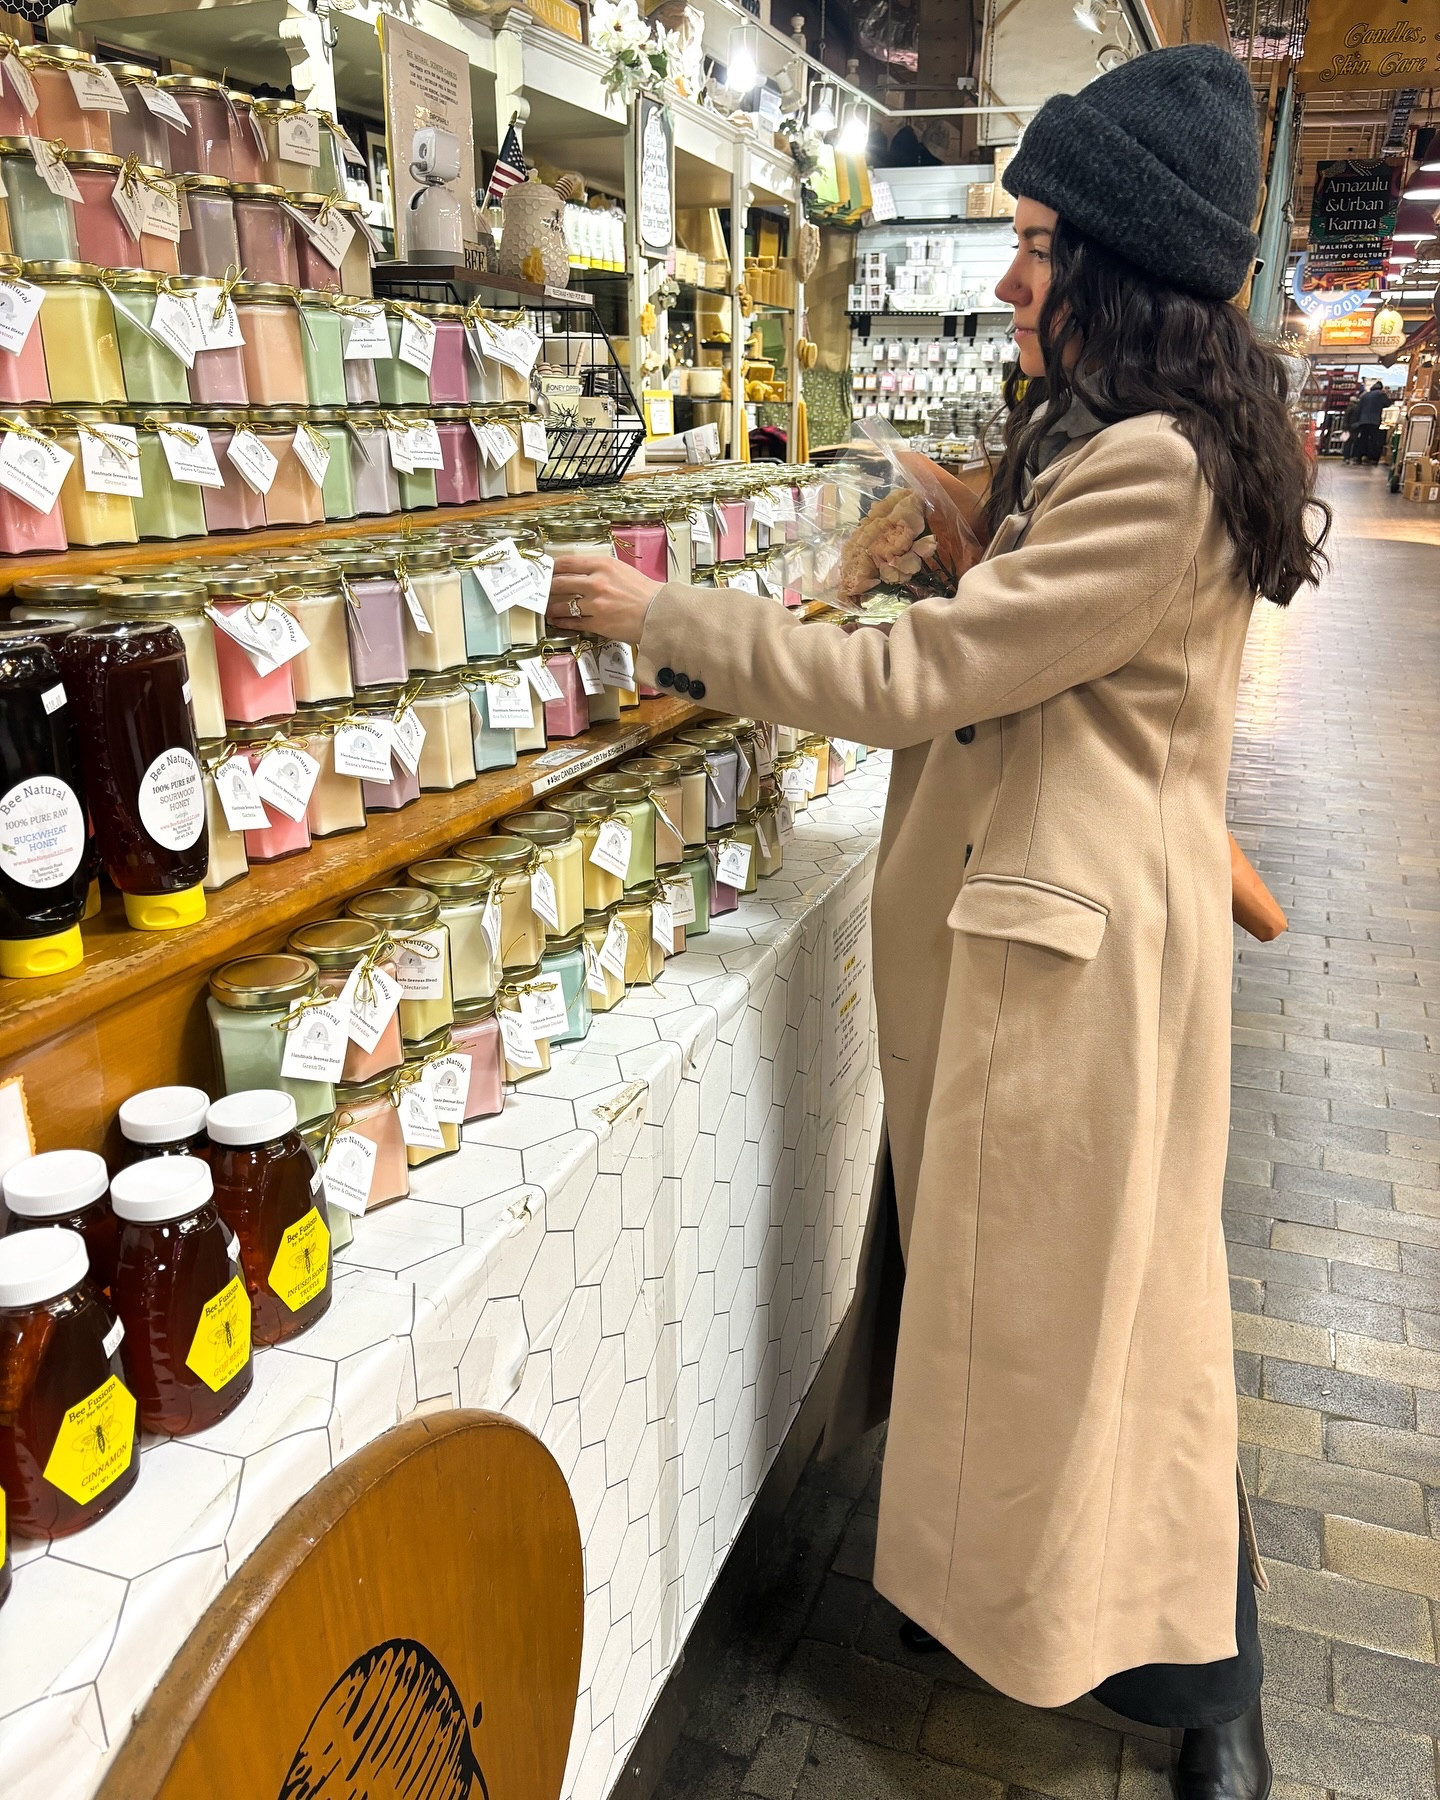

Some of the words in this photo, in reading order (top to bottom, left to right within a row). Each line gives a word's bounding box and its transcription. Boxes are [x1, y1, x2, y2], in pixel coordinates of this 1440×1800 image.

[1344, 21, 1426, 48] Candles,
[1319, 51, 1371, 82] Skin
[1378, 52, 1427, 77] Care
[1325, 177, 1389, 193] Amazulu
[1328, 218, 1377, 231] Karma
[464, 248, 486, 272] BEE
[34, 438, 60, 464] Natural
[280, 613, 297, 643] Natural
[341, 724, 354, 734] Bee
[354, 724, 383, 739] Natural
[150, 763, 166, 782] Bee
[166, 754, 194, 770] Natural
[276, 748, 290, 756] Bee
[290, 750, 312, 775] Natural
[560, 764, 580, 780] CANDLES
[152, 782, 170, 794] 100%
[170, 778, 186, 790] PURE
[186, 774, 196, 784] RAW
[159, 786, 195, 804] SOURWOOD
[0, 794, 22, 816] Bee
[23, 784, 66, 801] Natural
[169, 798, 191, 812] HONEY
[5, 818, 28, 830] 100%
[30, 812, 52, 826] PURE
[53, 808, 68, 820] RAW
[13, 824, 67, 845] BUCKWHEAT
[29, 837, 58, 852] HONEY
[373, 973, 391, 1000] Natural
[312, 1006, 341, 1026] Natural
[302, 1062, 317, 1070] Green
[431, 1058, 445, 1070] Bee
[446, 1058, 467, 1073] Natural
[334, 1135, 348, 1145] Bee
[349, 1136, 372, 1158] Natural
[286, 1231, 299, 1245] Bee
[299, 1215, 318, 1235] Fusions
[287, 1274, 312, 1298] INFUSED
[311, 1262, 327, 1281] HONEY
[299, 1279, 320, 1298] TRUFFLE
[204, 1303, 218, 1318] Bee
[218, 1282, 239, 1308] Fusions
[213, 1361, 228, 1378] GOJI
[229, 1341, 247, 1363] BERRY
[68, 1407, 86, 1423] Bee
[87, 1381, 116, 1410] Fusions
[86, 1410, 96, 1420] Bee
[96, 1394, 113, 1411] Natural
[81, 1441, 128, 1487] CINNAMON
[90, 1483, 100, 1493] Net
